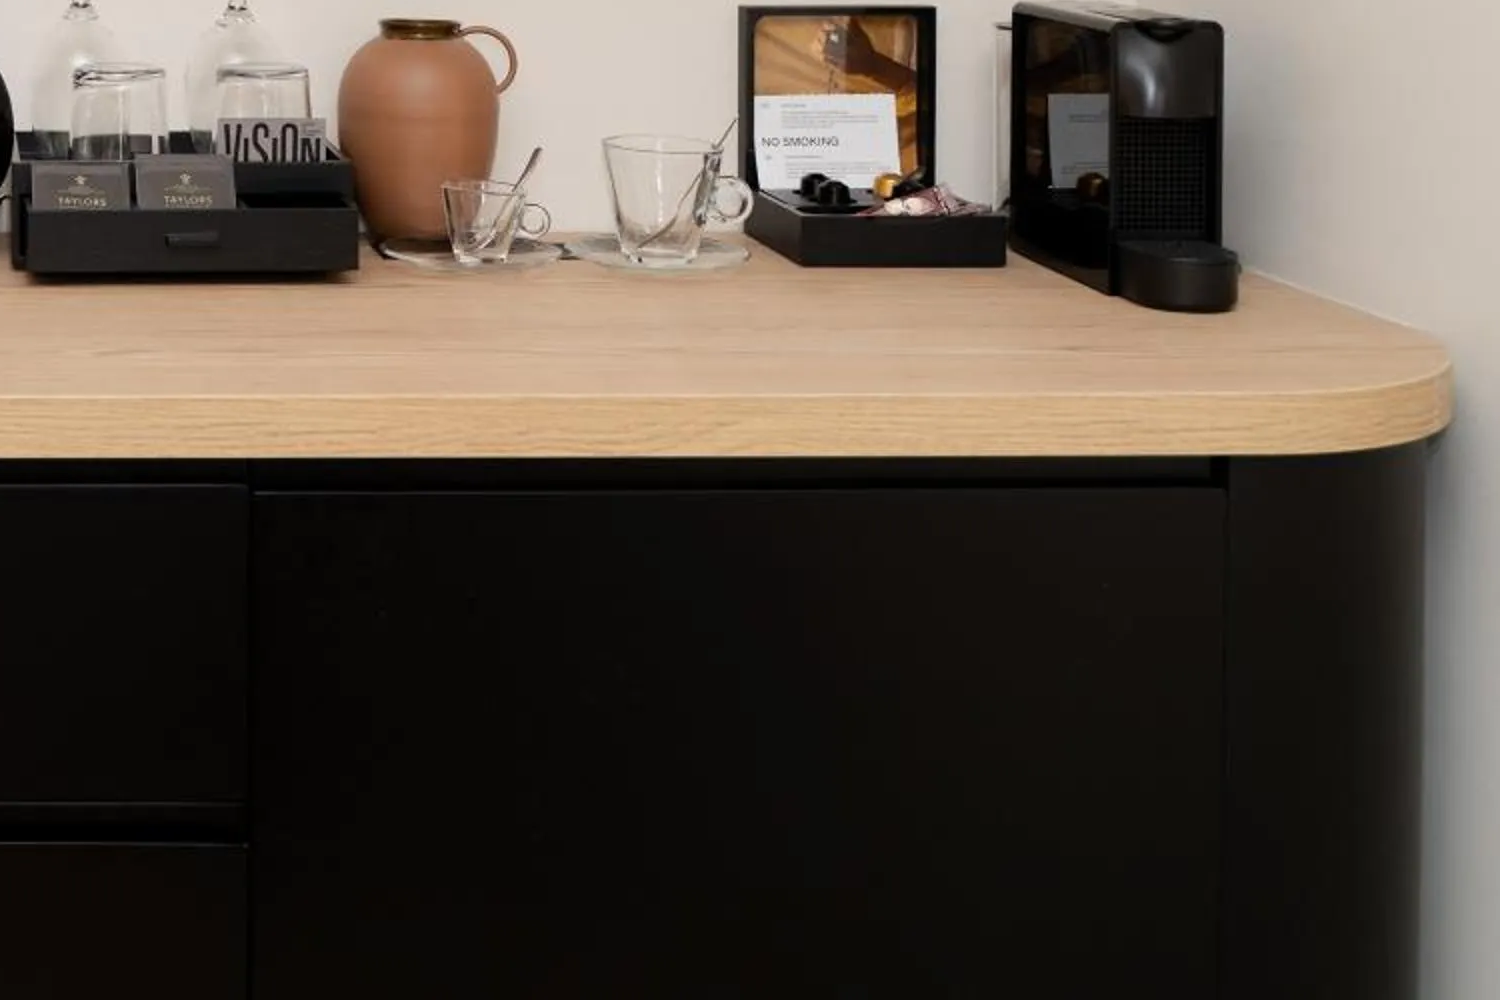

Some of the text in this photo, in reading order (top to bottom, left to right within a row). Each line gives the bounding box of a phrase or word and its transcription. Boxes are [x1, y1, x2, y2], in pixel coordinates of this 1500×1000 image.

[761, 135, 840, 148] NO SMOKING
[163, 194, 214, 207] TAYLORS
